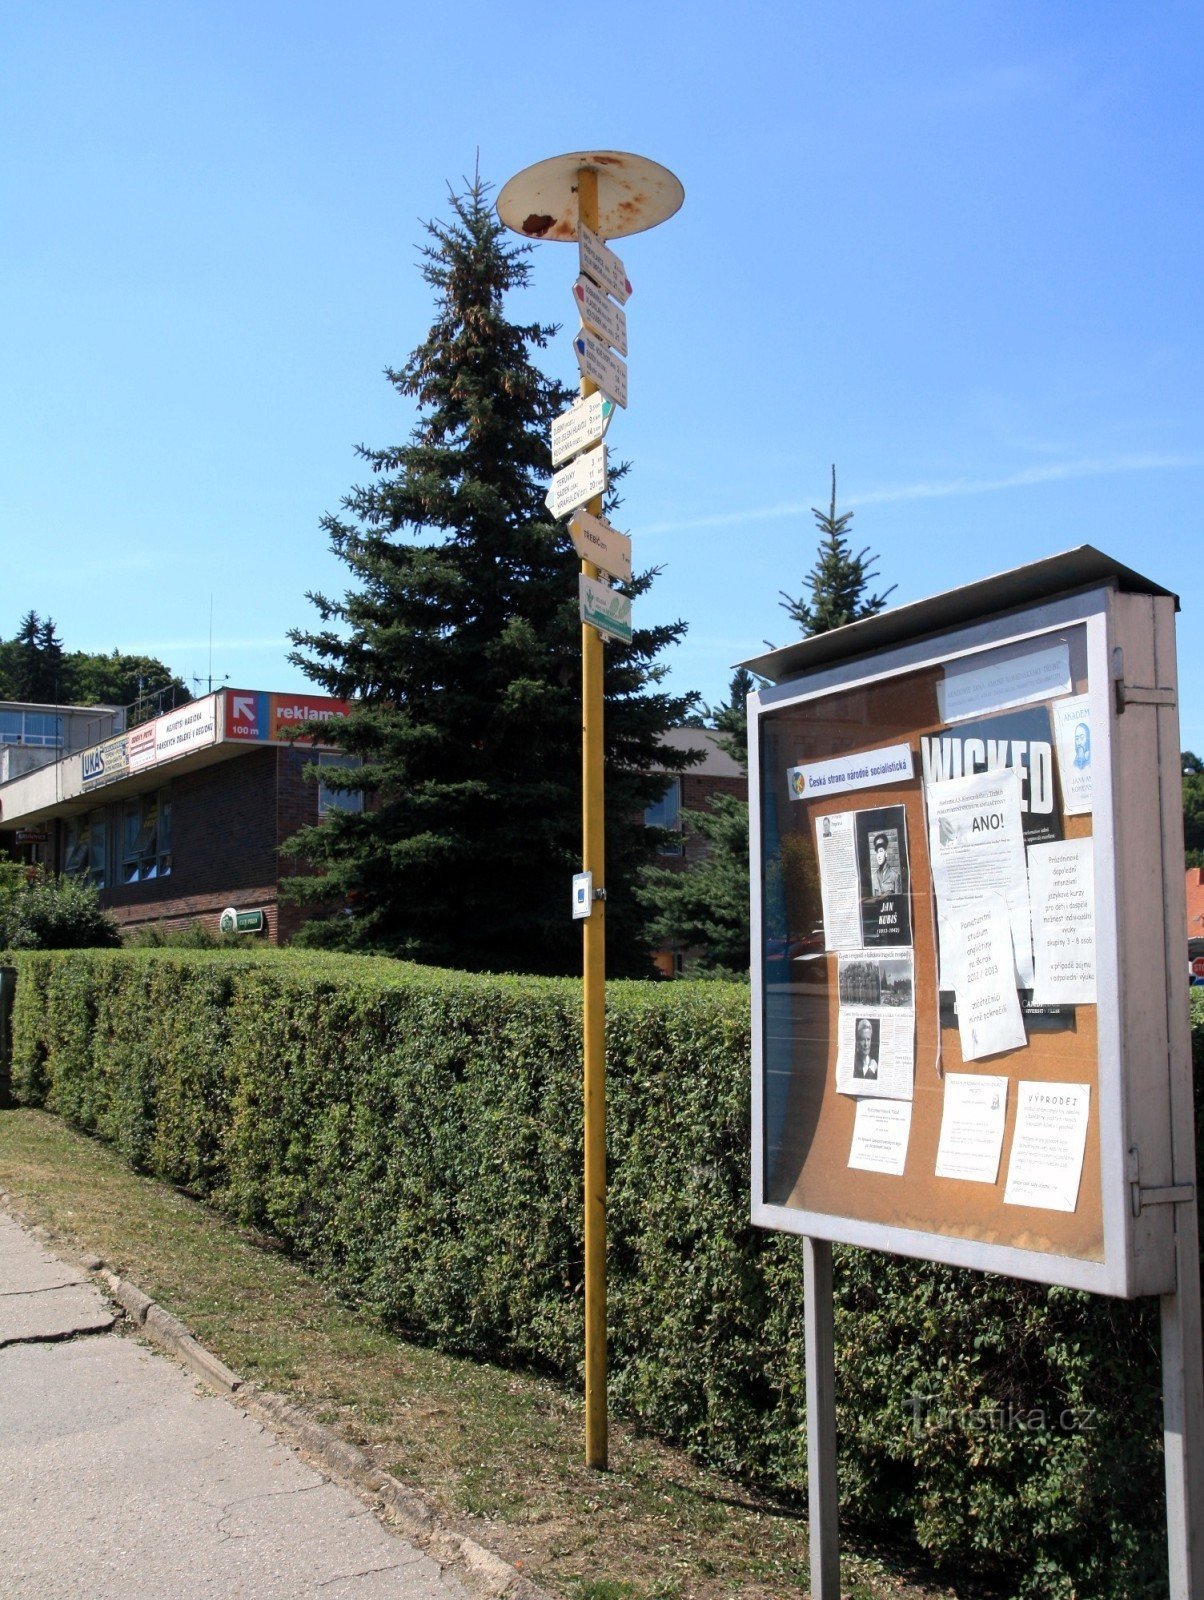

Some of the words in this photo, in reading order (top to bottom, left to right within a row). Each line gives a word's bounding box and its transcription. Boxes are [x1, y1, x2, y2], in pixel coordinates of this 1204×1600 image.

[232, 726, 249, 734] 100
[808, 775, 827, 788] Česká
[828, 772, 846, 785] strana
[846, 766, 870, 780] národně
[870, 758, 908, 776] socialistická
[972, 812, 1005, 832] ANO!
[880, 902, 894, 912] JAN
[878, 912, 898, 925] KUBIŠ
[1028, 1092, 1078, 1106] VÝPRODEJ
